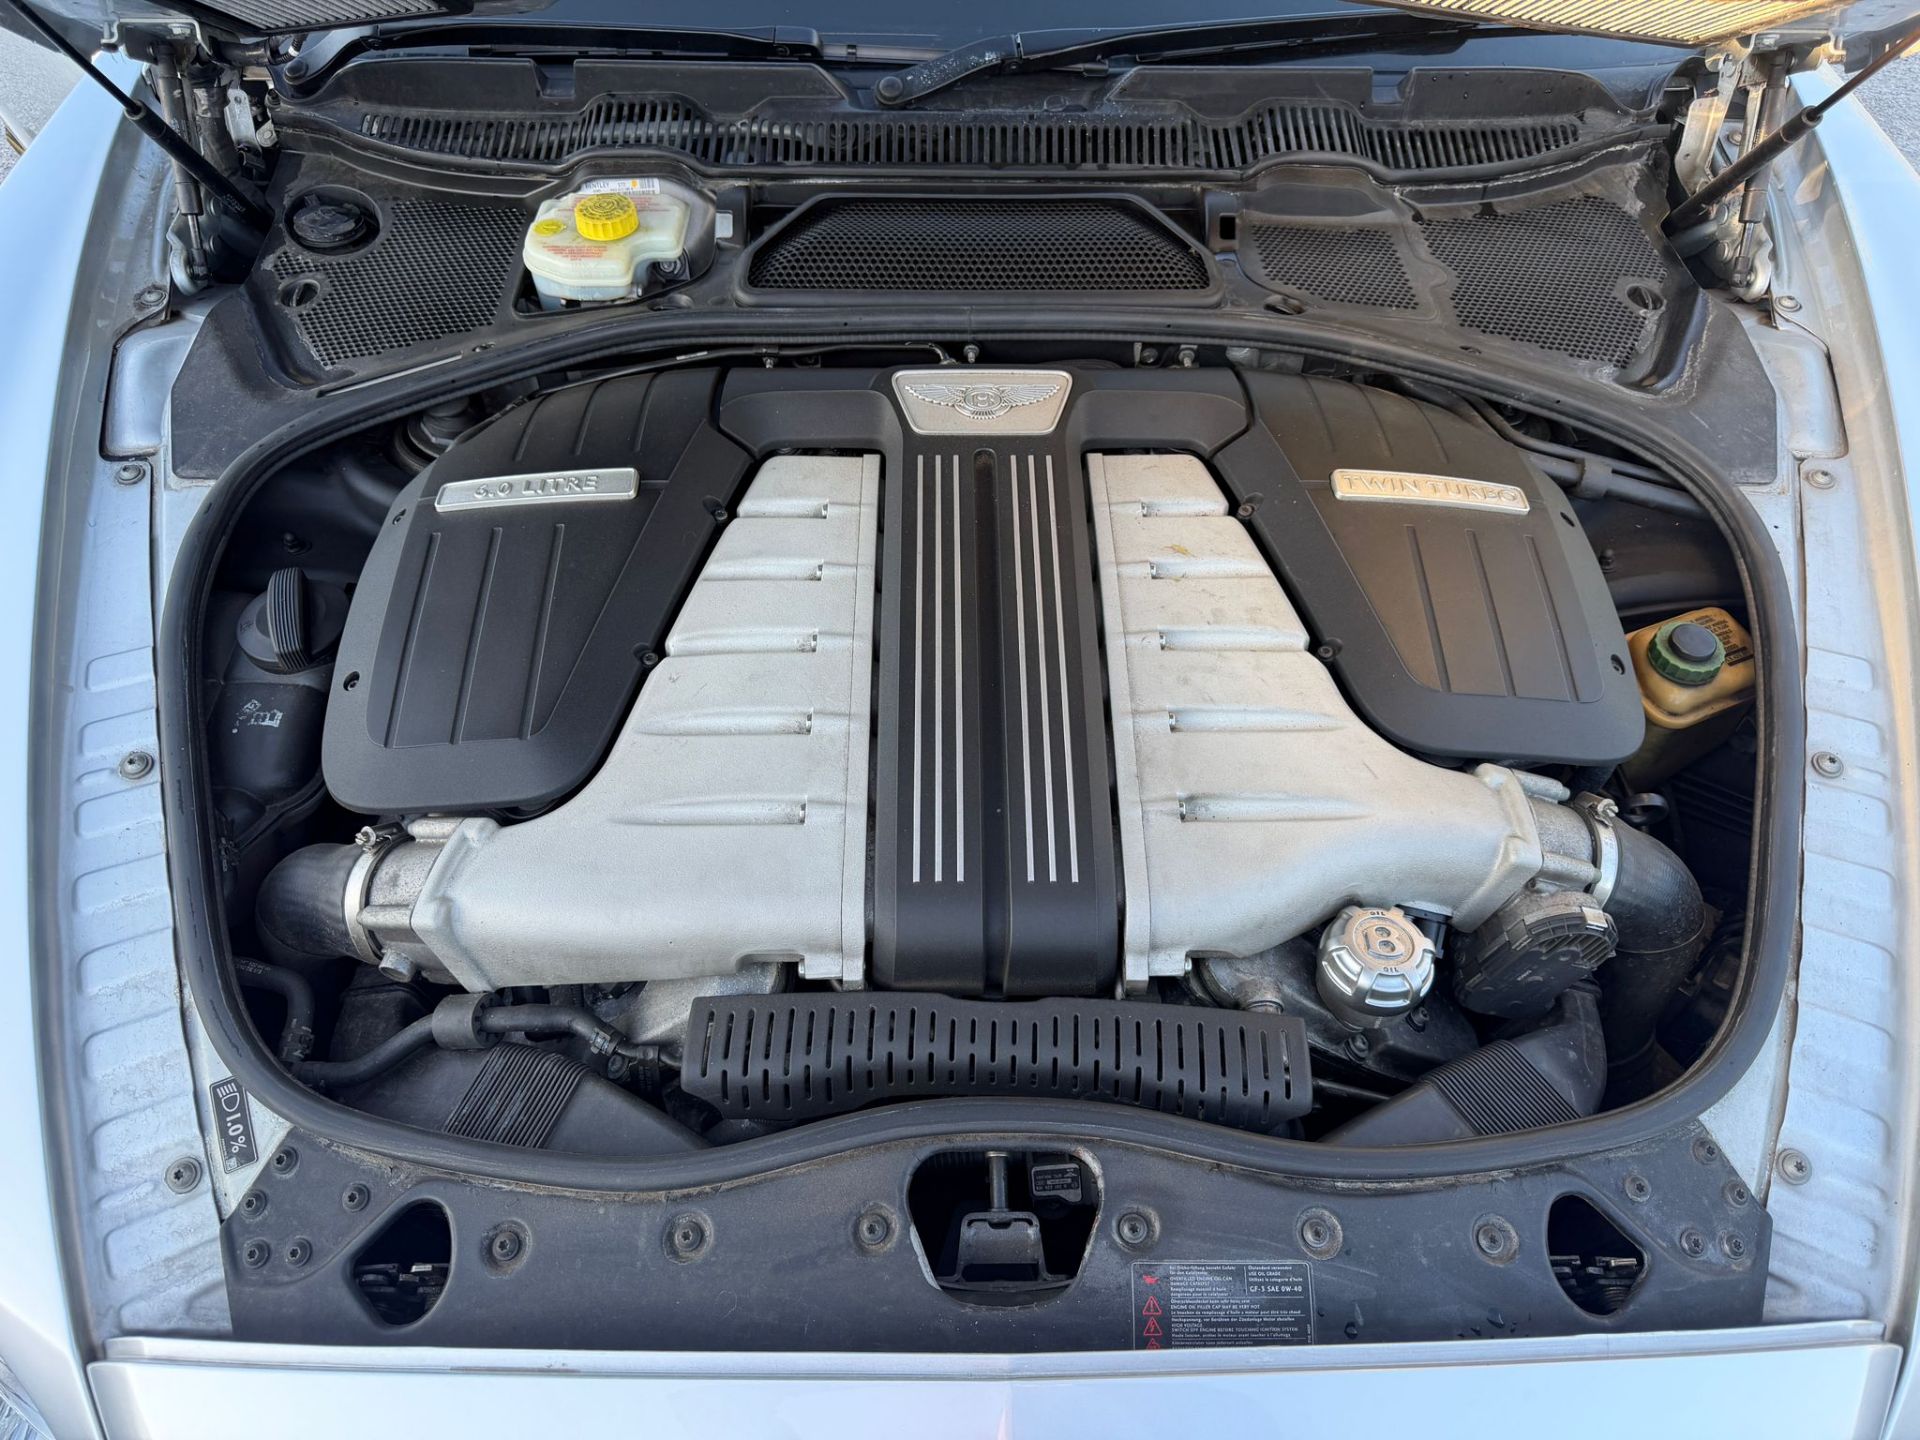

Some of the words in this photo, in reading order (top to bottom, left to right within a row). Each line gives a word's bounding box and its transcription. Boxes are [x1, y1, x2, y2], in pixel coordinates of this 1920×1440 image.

[474, 481, 514, 499] 6.0
[522, 475, 599, 496] LITRE
[1343, 474, 1421, 494] TWIN
[1425, 480, 1518, 501] TURBO
